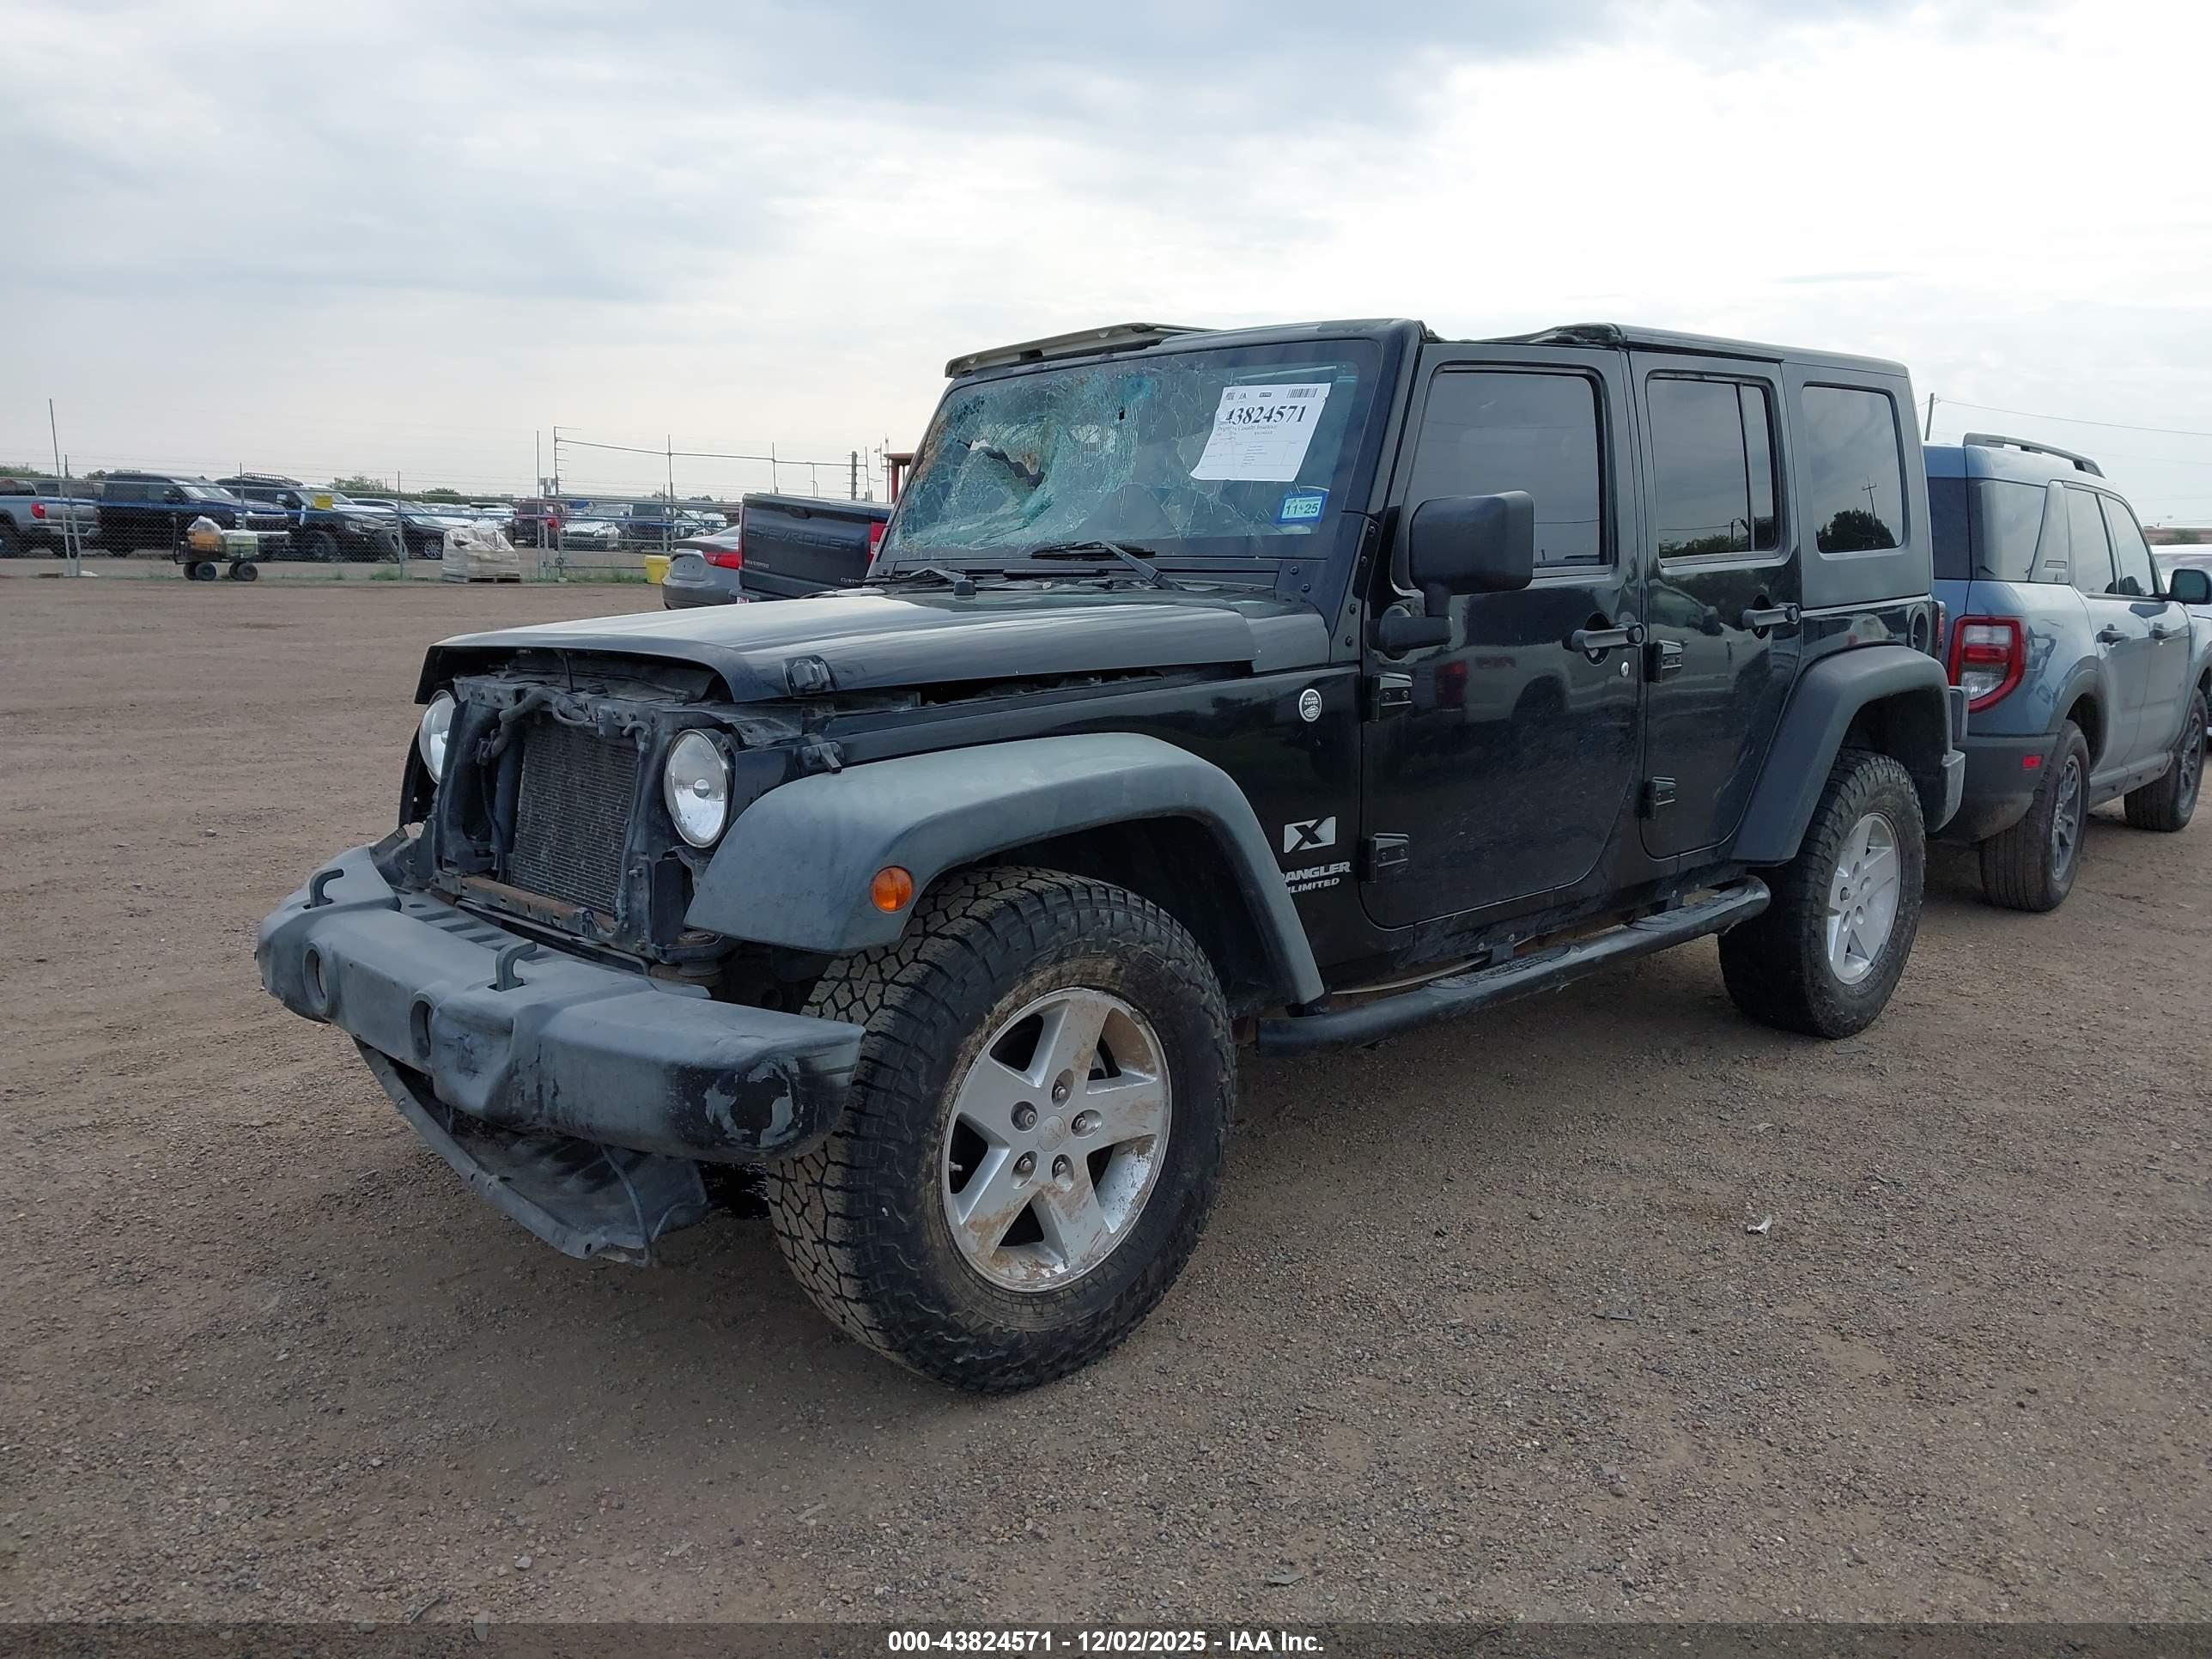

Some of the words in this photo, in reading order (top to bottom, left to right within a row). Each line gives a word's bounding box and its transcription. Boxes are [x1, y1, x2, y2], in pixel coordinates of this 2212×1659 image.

[1225, 405, 1307, 424] 43824571
[747, 523, 857, 551] CHEVROLET
[1285, 861, 1352, 883] ANGLER
[1288, 878, 1340, 894] LIMITED
